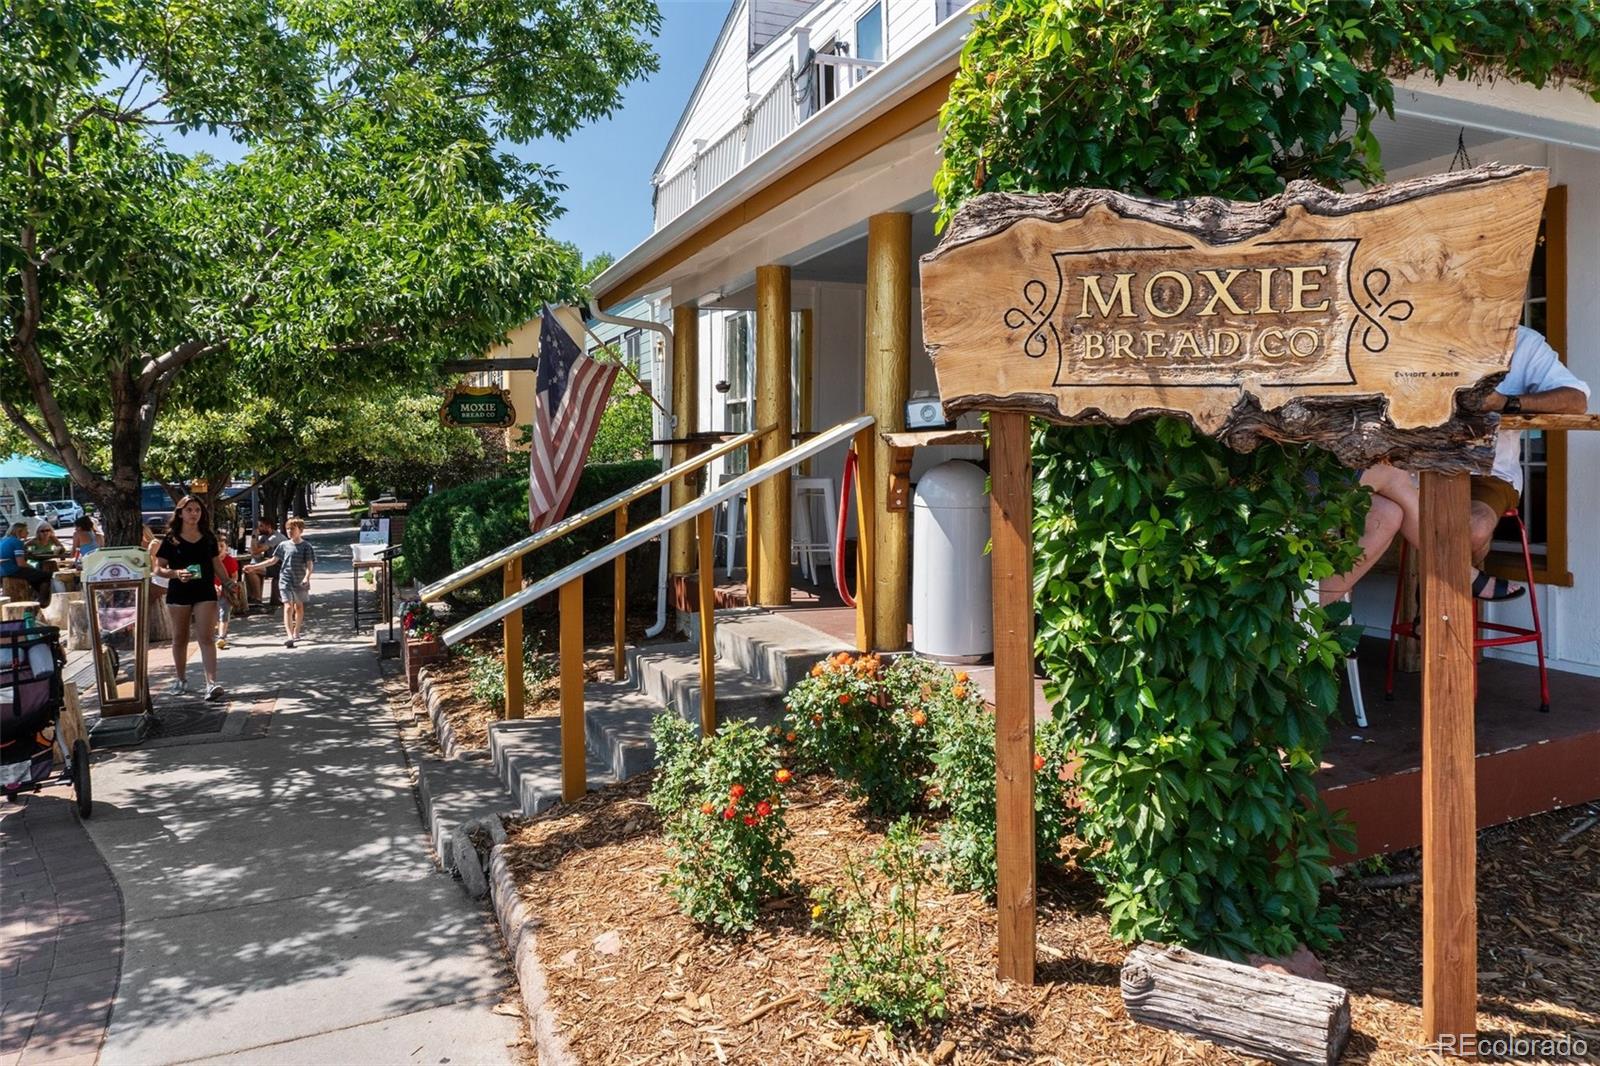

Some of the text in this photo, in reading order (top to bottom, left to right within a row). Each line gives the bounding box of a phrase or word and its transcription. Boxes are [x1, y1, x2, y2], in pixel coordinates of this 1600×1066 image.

[1075, 265, 1331, 318] MOXIE
[1083, 329, 1321, 360] BREAD CO
[460, 403, 496, 412] MOXIE
